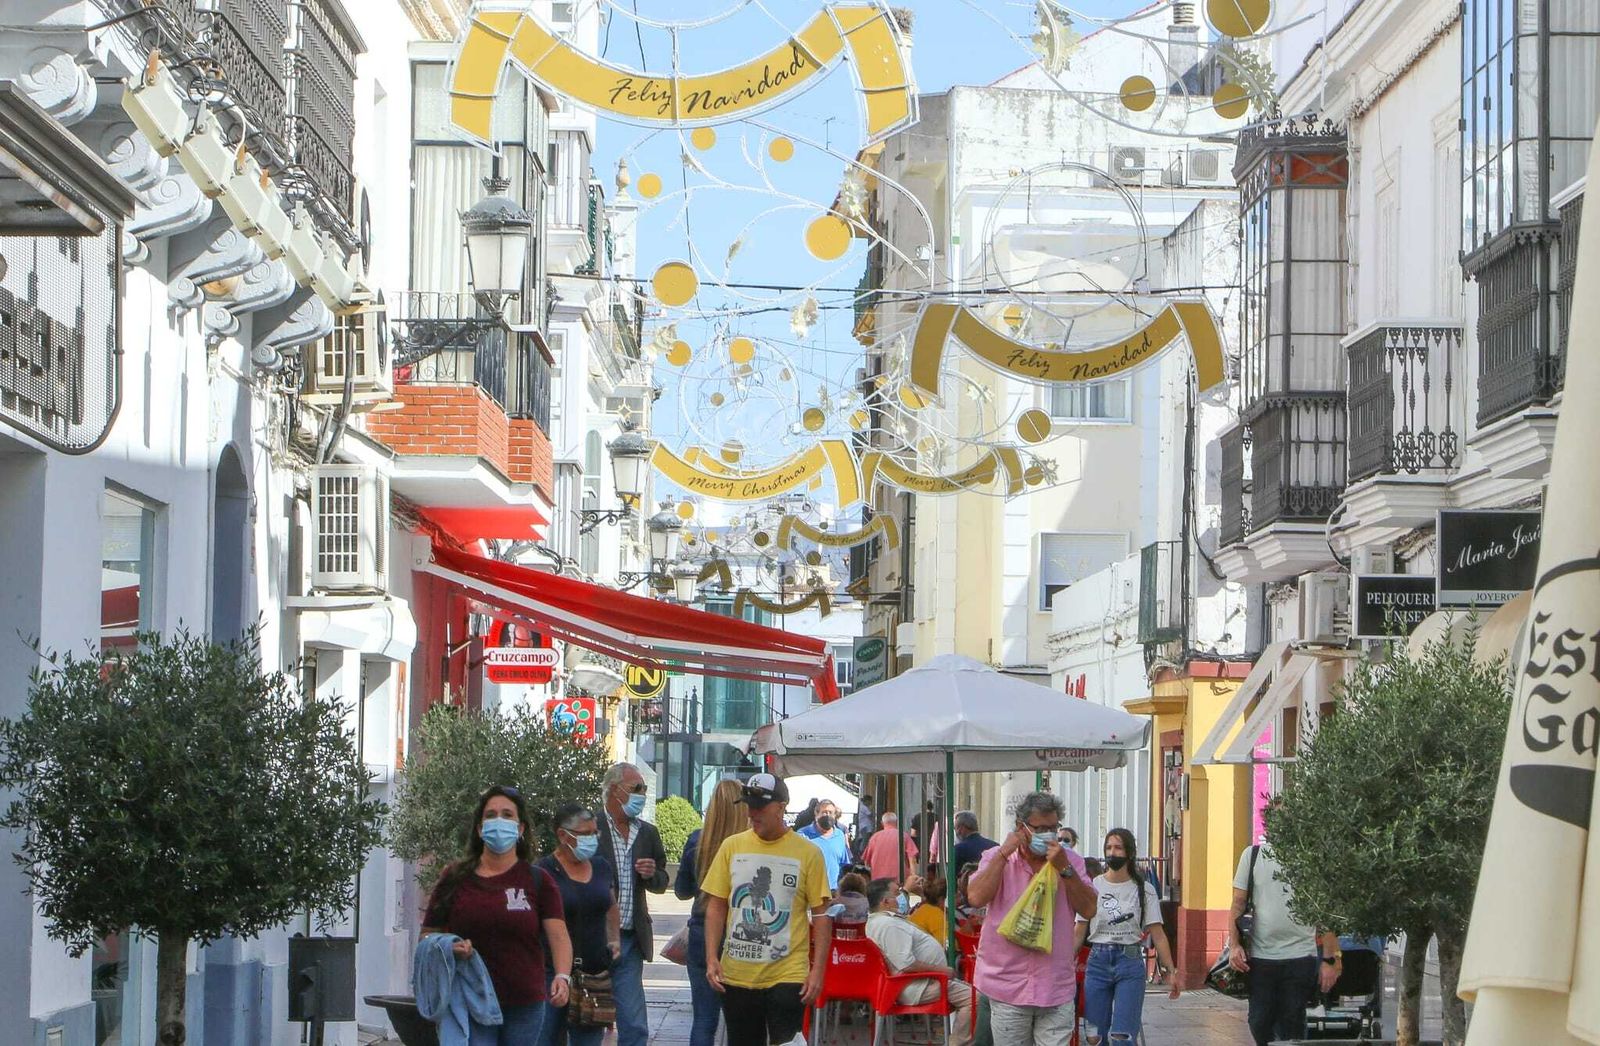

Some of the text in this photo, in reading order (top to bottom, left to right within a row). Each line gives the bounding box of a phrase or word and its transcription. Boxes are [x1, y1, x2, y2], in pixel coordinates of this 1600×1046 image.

[608, 46, 805, 115] Feliz Navidad
[1007, 331, 1153, 379] Feliz Navidad
[688, 464, 807, 497] Merry Christmas
[904, 475, 935, 490] Merry
[1476, 593, 1519, 601] JOYERO
[488, 651, 554, 665] Cruzcampo
[628, 666, 660, 687] IN
